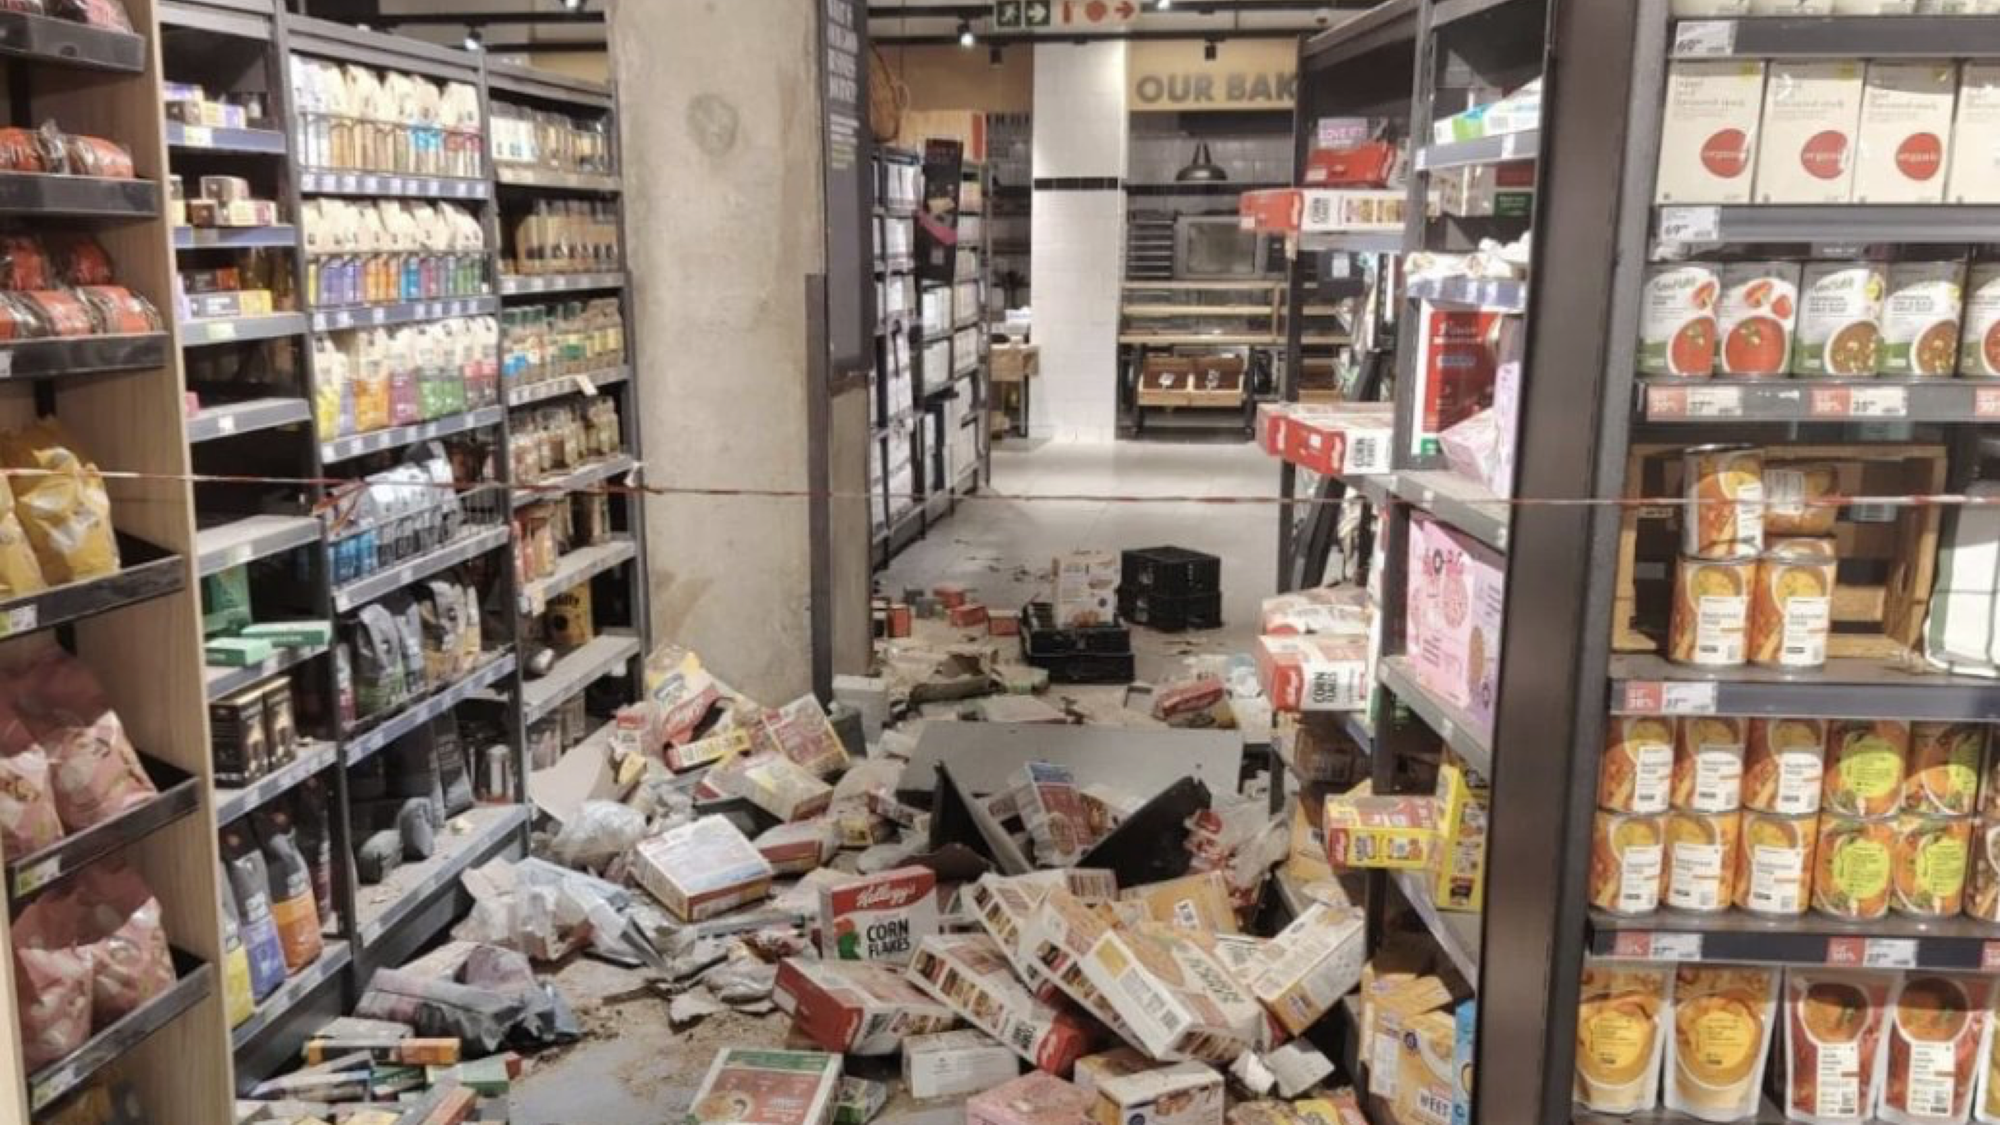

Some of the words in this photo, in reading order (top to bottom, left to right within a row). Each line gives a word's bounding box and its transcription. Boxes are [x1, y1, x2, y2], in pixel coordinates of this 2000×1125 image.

[1136, 73, 1214, 103] OUR
[1227, 72, 1298, 102] BAK
[1313, 671, 1326, 703] CORN
[866, 917, 909, 943] CORN
[867, 937, 910, 959] FLAKES
